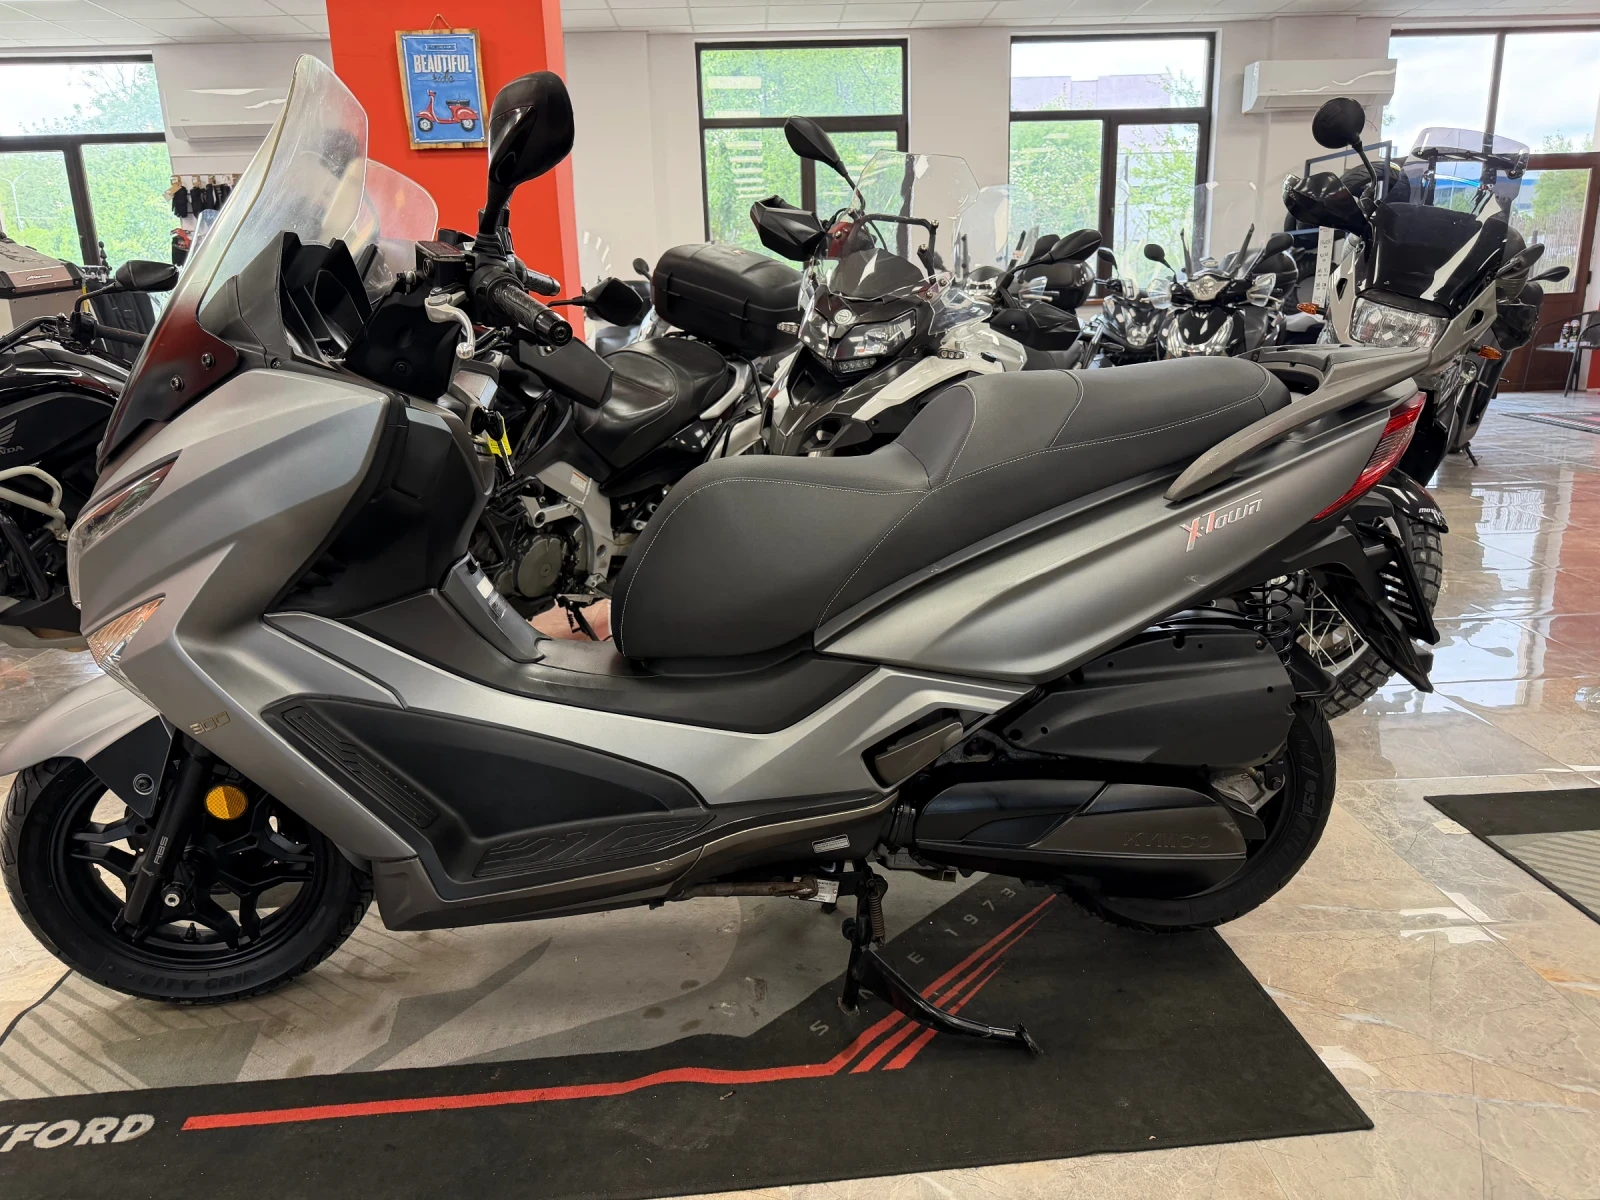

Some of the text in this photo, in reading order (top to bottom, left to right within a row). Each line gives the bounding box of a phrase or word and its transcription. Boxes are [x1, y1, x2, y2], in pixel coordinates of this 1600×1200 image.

[413, 54, 472, 73] BEAUTIFUL
[190, 711, 231, 735] 300
[153, 836, 169, 865] ABS
[1123, 832, 1214, 849] KYMCO
[944, 886, 1017, 937] 1973
[139, 969, 258, 992] CITY GRIP
